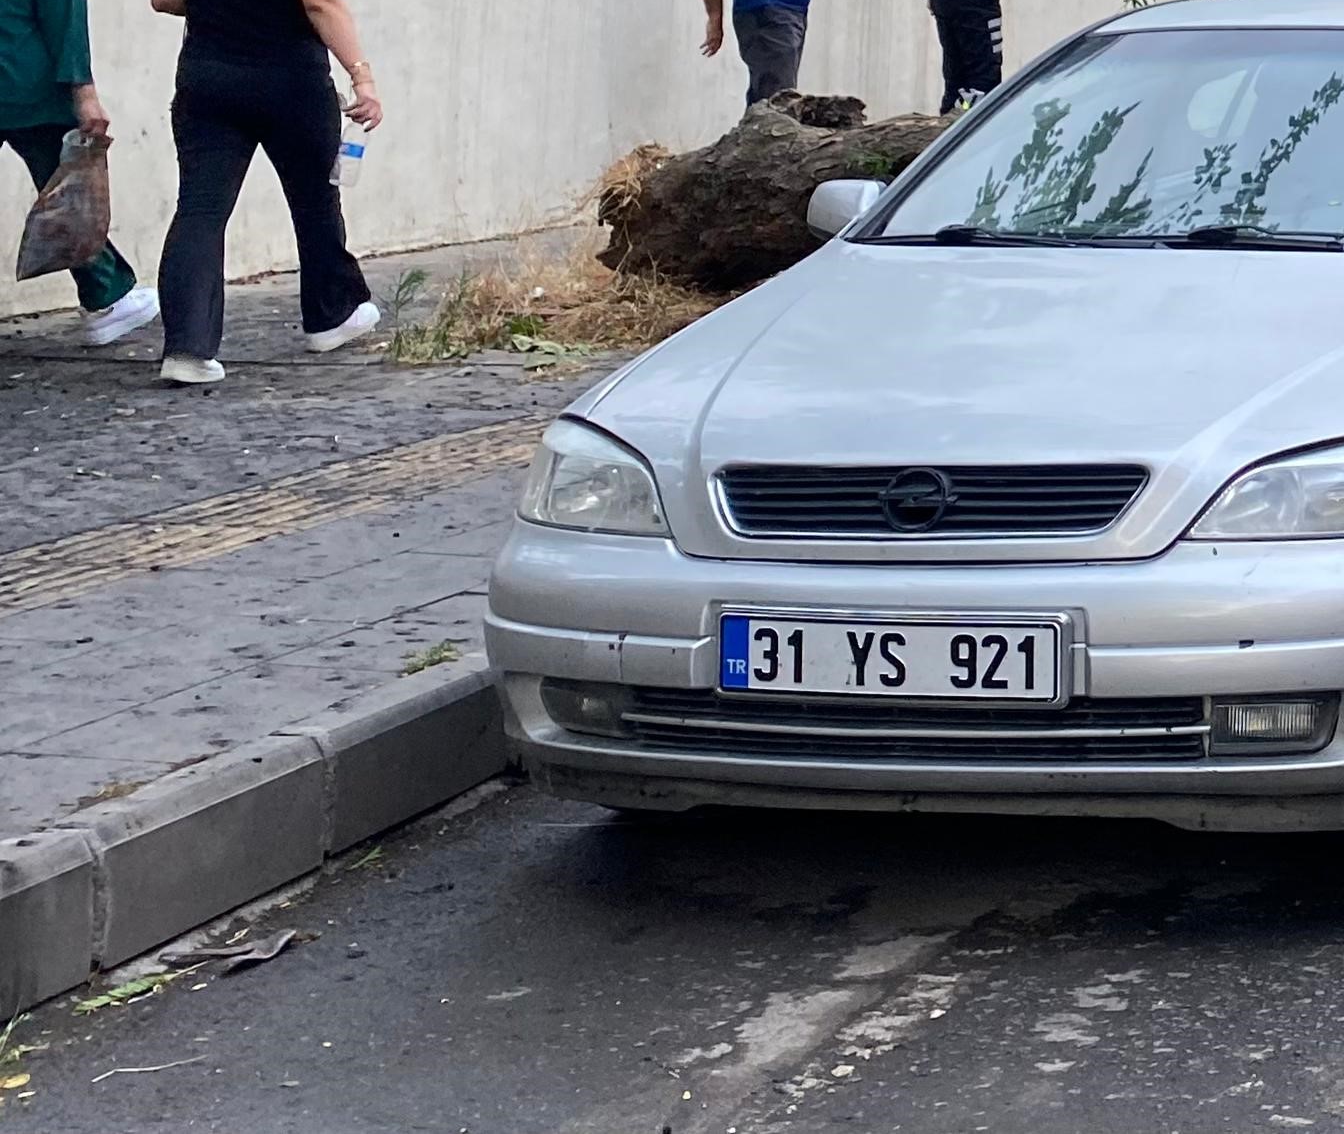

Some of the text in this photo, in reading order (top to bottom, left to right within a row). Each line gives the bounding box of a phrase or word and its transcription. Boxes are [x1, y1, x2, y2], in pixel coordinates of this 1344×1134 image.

[726, 627, 1036, 690] TR 31 YS 921
